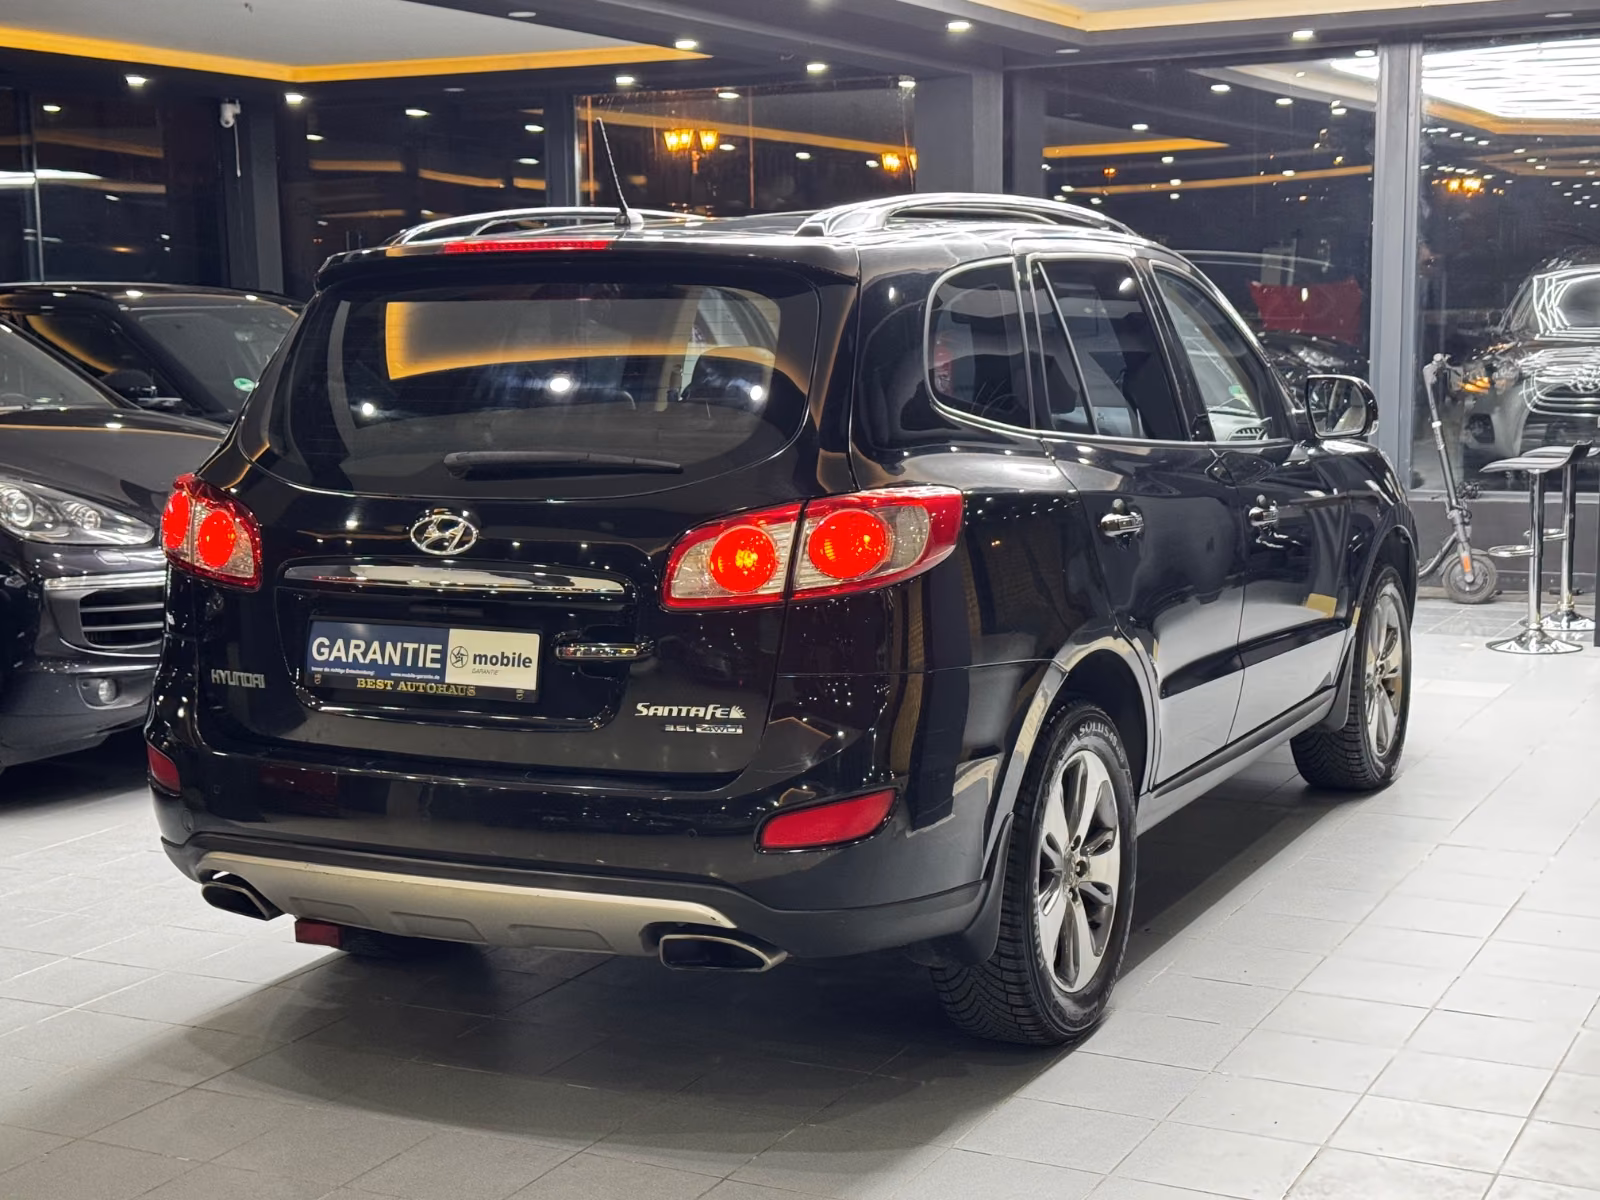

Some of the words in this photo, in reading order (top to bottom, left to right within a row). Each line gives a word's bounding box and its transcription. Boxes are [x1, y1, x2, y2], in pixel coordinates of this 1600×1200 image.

[311, 636, 443, 669] GARANTIE
[472, 651, 533, 668] mobile
[211, 668, 266, 689] HYUNDAI
[471, 667, 500, 676] GARANTIE
[356, 677, 394, 690] BEST
[397, 680, 476, 696] AUTOHAUS
